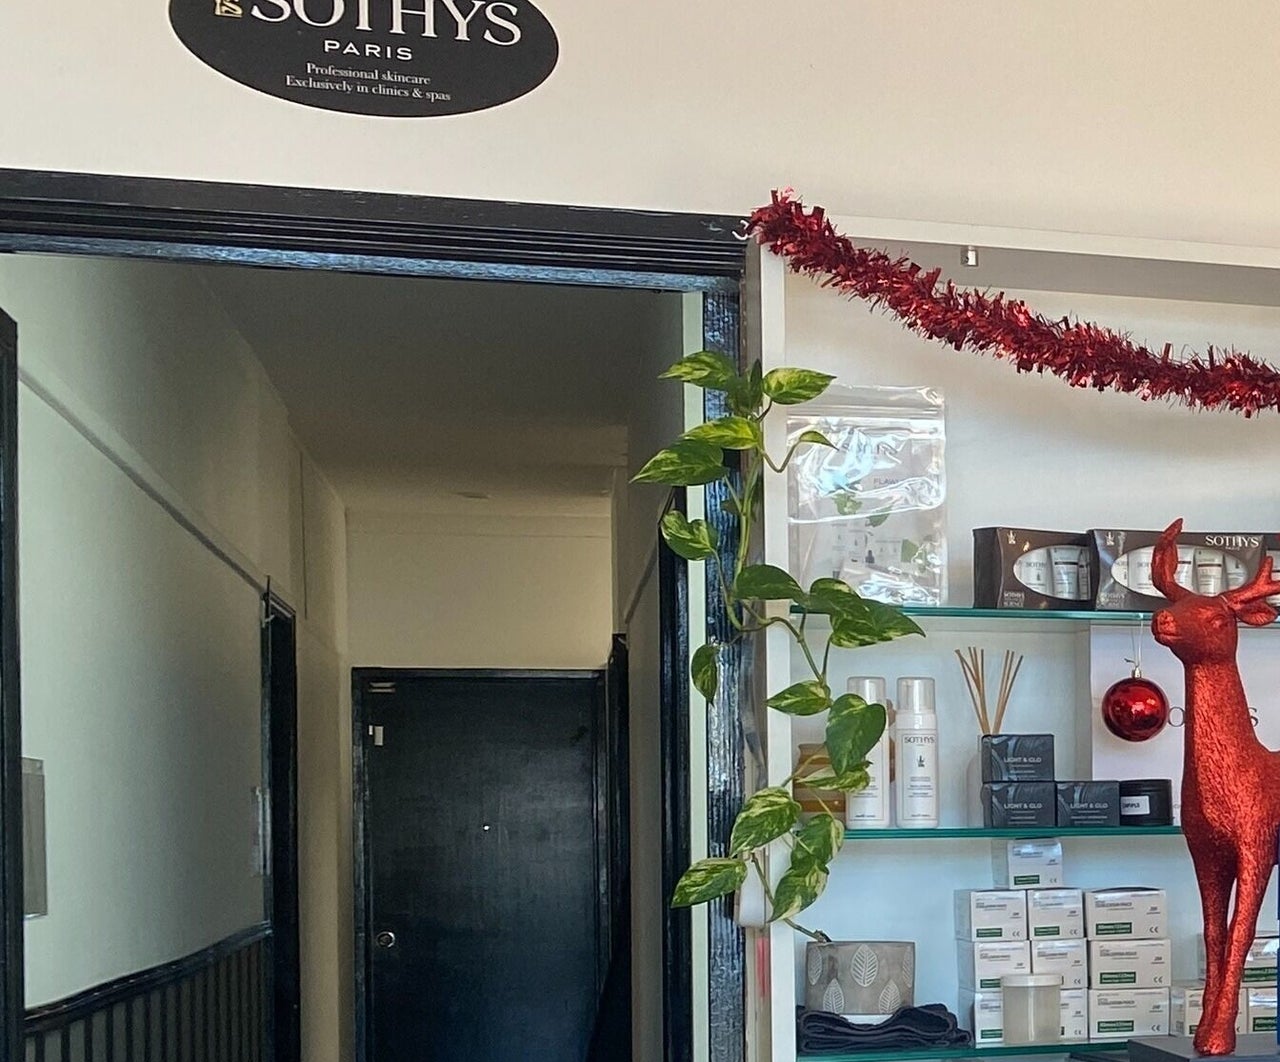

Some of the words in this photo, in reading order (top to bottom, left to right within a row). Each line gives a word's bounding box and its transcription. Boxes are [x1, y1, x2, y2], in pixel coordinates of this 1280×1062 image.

[250, 0, 522, 46] SOTHYS
[324, 39, 413, 60] PARIS
[306, 62, 379, 82] Professional
[380, 68, 431, 85] skincare
[285, 74, 353, 94] Exclusively
[356, 82, 369, 94] in
[371, 83, 410, 98] clinics
[412, 86, 423, 99] &
[425, 89, 451, 102] spas
[1206, 535, 1258, 548] SOTHYS
[904, 736, 935, 744] SOTHYS
